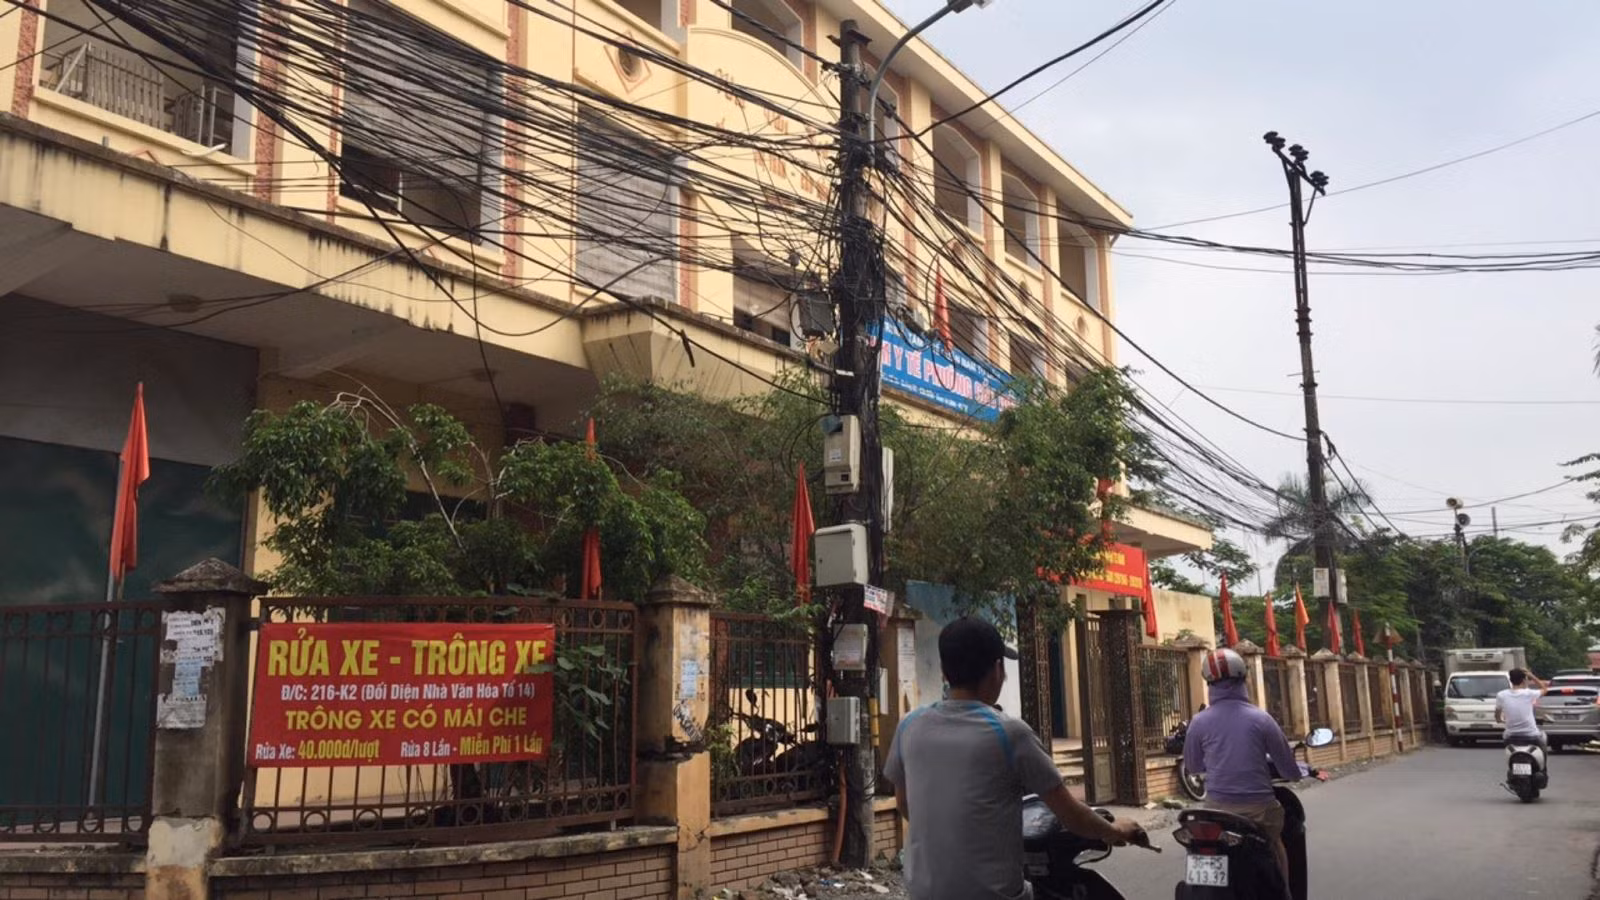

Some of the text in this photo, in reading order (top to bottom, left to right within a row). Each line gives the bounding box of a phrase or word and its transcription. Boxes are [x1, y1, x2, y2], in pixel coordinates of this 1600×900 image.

[892, 345, 904, 371] Y
[267, 627, 330, 677] RỬA
[339, 639, 380, 676] XE
[411, 632, 506, 676] TRÔNG
[513, 640, 546, 675] XE
[281, 684, 308, 701] Đ/C:
[310, 684, 357, 701] 216-K2
[361, 682, 388, 702] (Đối
[390, 683, 420, 703] Diện
[422, 683, 448, 700] Nhà
[451, 683, 474, 699] Văn
[476, 682, 499, 699] Hóa
[517, 682, 535, 699] 14)
[286, 703, 527, 730] TRÔNG XE CÓ MÁI CHE
[278, 744, 296, 760] Xe:
[423, 741, 430, 757] 8
[459, 732, 490, 756] Miễn
[492, 734, 512, 754] Phí
[514, 734, 520, 753] 1
[1188, 870, 1226, 885] 413.32
